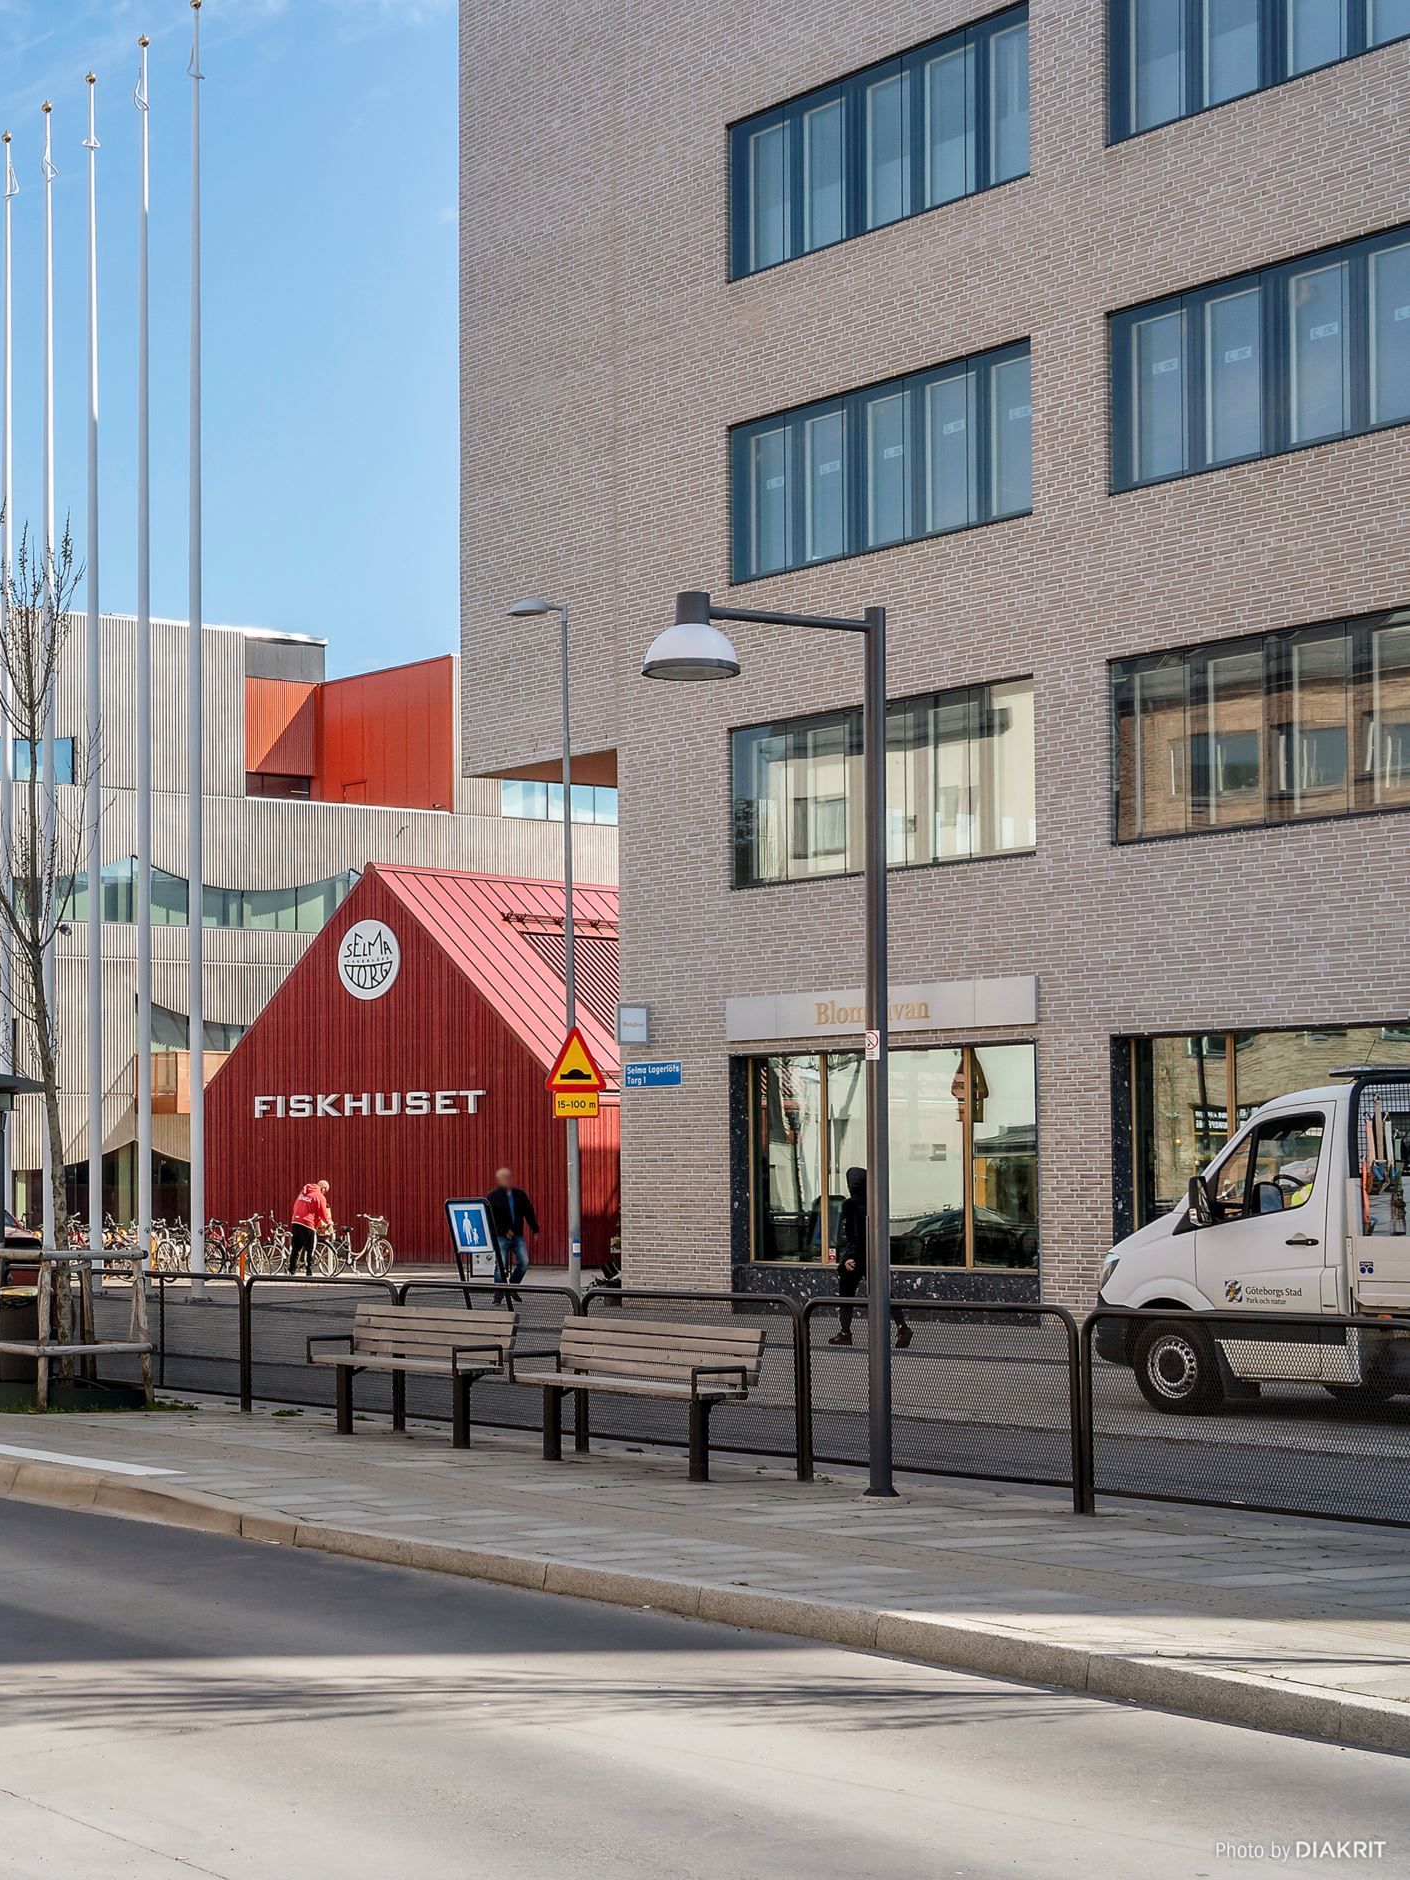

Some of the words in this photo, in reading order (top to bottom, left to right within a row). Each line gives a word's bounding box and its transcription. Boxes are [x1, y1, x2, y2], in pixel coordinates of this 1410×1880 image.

[344, 929, 392, 958] SELMA
[344, 960, 393, 990] TORG
[626, 1065, 647, 1075] Selma
[648, 1064, 680, 1075] Lagerlöfs
[626, 1076, 642, 1085] Torg
[254, 1089, 487, 1119] FISKHUSET
[557, 1100, 586, 1109] 15-100
[589, 1101, 596, 1109] m
[1245, 1286, 1284, 1298] Göteborgs
[1285, 1287, 1303, 1297] Stad
[1259, 1297, 1270, 1305] och
